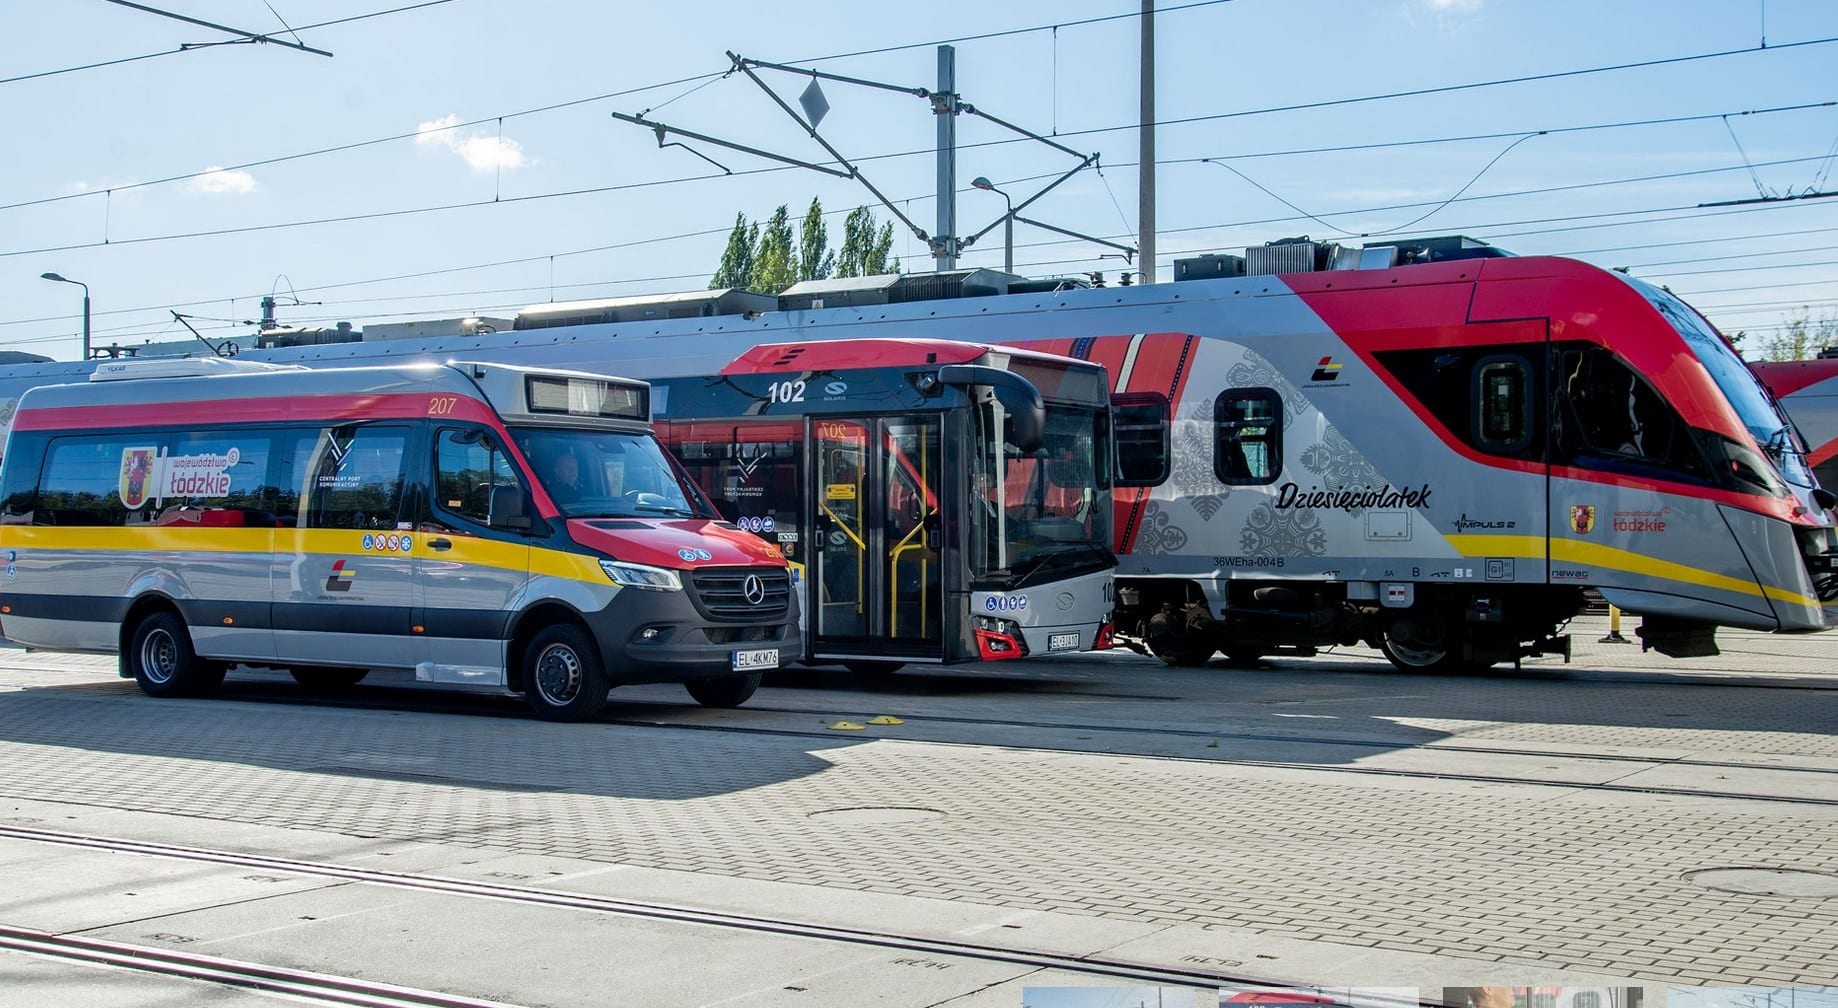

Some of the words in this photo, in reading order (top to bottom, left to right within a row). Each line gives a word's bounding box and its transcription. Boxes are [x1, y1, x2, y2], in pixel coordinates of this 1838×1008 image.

[768, 380, 806, 403] 102
[428, 397, 457, 415] 207
[1275, 482, 1432, 512] Dziesięciolatek
[1460, 520, 1505, 529] IMPULS
[1412, 567, 1420, 577] B
[738, 653, 750, 666] EL
[753, 651, 777, 665] 4KM76
